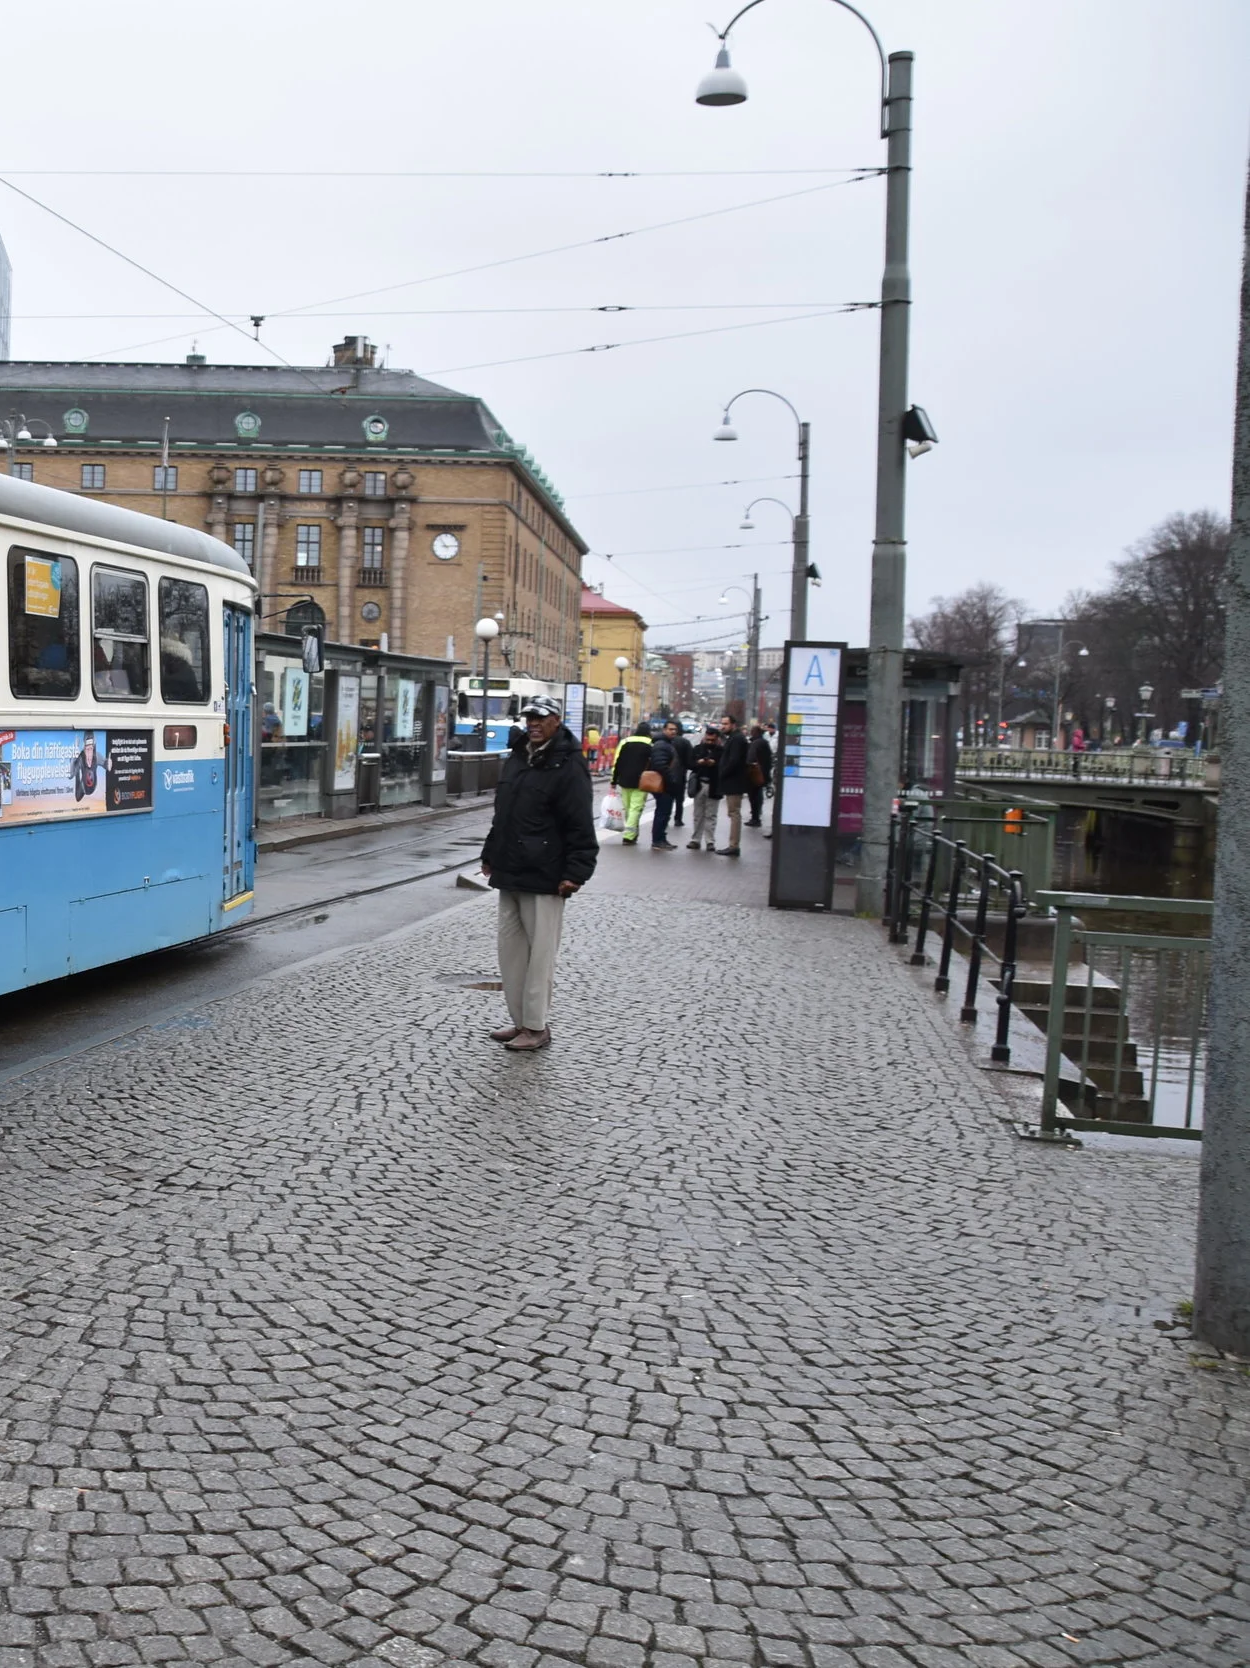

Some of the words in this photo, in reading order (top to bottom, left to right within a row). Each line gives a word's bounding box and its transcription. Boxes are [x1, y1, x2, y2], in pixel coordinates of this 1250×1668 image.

[804, 655, 825, 686] A
[11, 743, 31, 760] Boka
[32, 742, 44, 760] din
[44, 741, 80, 762] häftigaste
